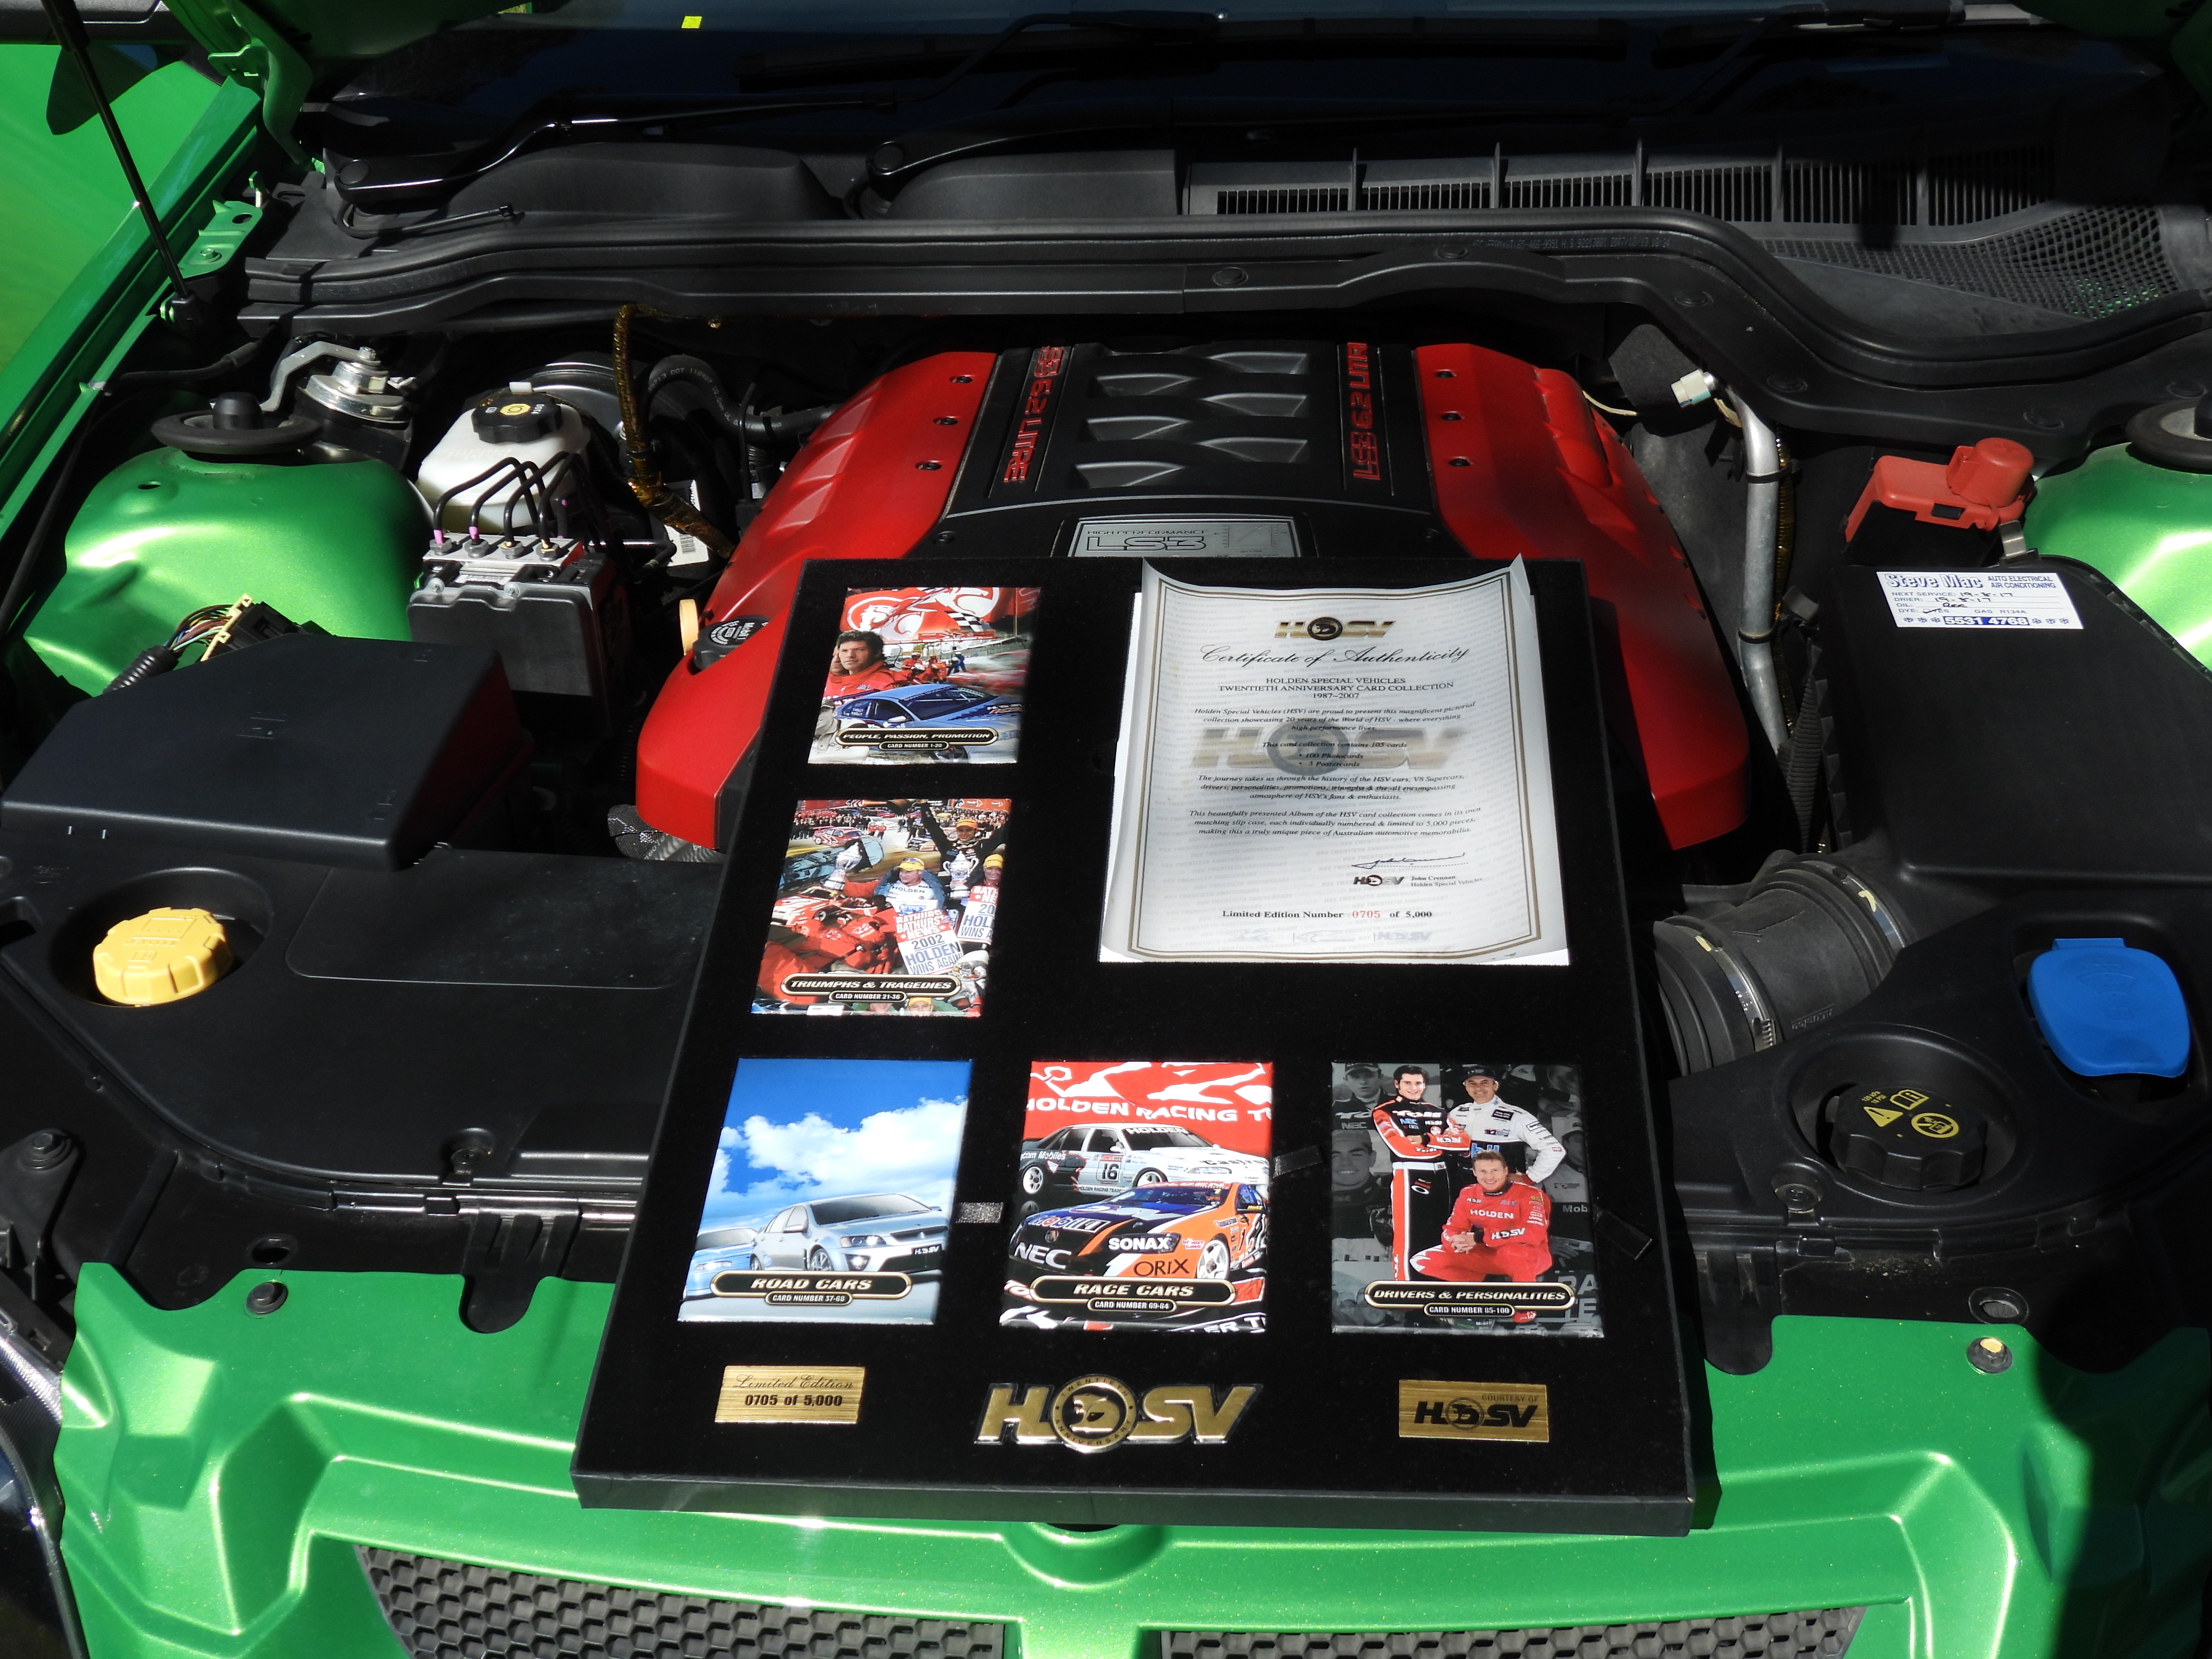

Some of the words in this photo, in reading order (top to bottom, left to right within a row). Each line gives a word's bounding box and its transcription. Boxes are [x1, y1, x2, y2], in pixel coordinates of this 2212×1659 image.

[1004, 418, 1042, 482] LITRE
[1350, 431, 1381, 480] LS3
[1087, 537, 1206, 551] LS3
[1885, 574, 1939, 588] Steve
[1940, 574, 1983, 588] Mac
[1274, 617, 1395, 640] HSV
[1200, 645, 1299, 667] Certificate
[1304, 649, 1334, 667] of
[1334, 646, 1469, 662] Authenticity
[1388, 682, 1454, 691] COLLECTION
[1450, 818, 1475, 826] pieces.
[1353, 874, 1404, 886] HSV
[1457, 877, 1483, 886] Vehicles
[1222, 910, 1263, 918] Limited
[1264, 910, 1300, 918] Edition
[1303, 911, 1344, 919] Number
[1352, 910, 1381, 919] 0705
[1405, 911, 1432, 919] 5,000
[896, 915, 944, 933] BATHURST
[907, 926, 940, 940] NEWS
[961, 926, 984, 937] WINS
[912, 934, 945, 950] 2002
[905, 941, 961, 966] HOLDEN
[910, 961, 935, 974] WINS
[791, 980, 861, 988] TRIUMPHS
[879, 981, 952, 989] TRAGEDIES
[1136, 1106, 1237, 1122] RACING
[1037, 1151, 1066, 1161] Mobiles
[1104, 1163, 1119, 1180] 16
[1470, 1209, 1514, 1219] HOLDEN
[1108, 1237, 1171, 1250] SONAX
[1014, 1242, 1071, 1269] NEC
[750, 1278, 810, 1289] ROAD
[815, 1279, 873, 1290] CARS
[1073, 1283, 1130, 1296] RACE
[1136, 1284, 1194, 1296] CARS
[1374, 1290, 1436, 1298] DRIVERS
[1438, 1290, 1452, 1298] &
[1456, 1291, 1565, 1300] PERSONALITIES
[1094, 1301, 1115, 1309] CARD
[1116, 1301, 1147, 1309] NUMBER
[733, 1374, 798, 1388] Limited
[800, 1374, 853, 1388] Edition
[1060, 1378, 1129, 1397] TWENTIETH
[745, 1395, 778, 1406] 0705
[784, 1395, 799, 1405] of
[803, 1395, 842, 1407] 5,000
[974, 1378, 1263, 1450] HSV
[1414, 1398, 1538, 1429] HSV
[1055, 1419, 1131, 1445] ANNIVERSARY
